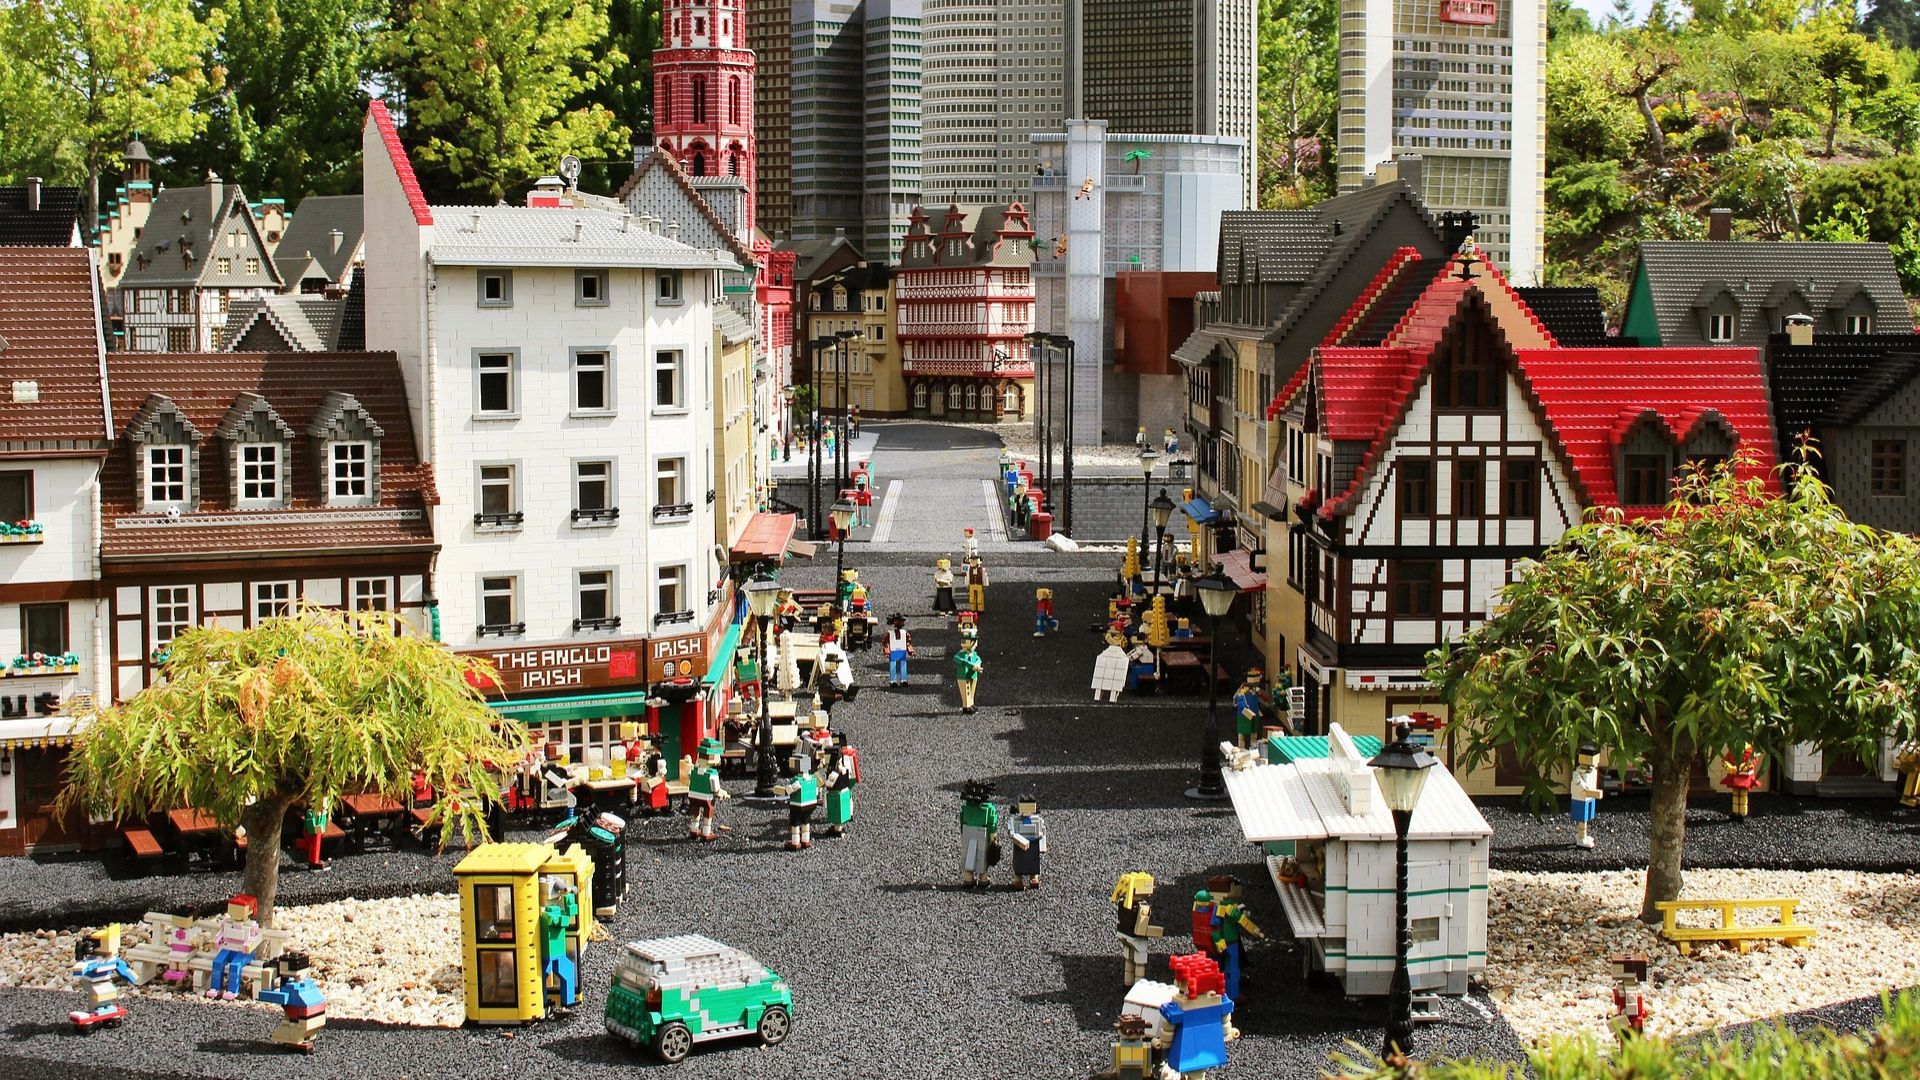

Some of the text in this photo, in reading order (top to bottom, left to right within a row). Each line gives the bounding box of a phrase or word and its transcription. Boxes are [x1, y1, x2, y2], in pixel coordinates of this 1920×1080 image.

[492, 646, 611, 669] THE ANGLO
[654, 638, 701, 658] IRISH
[523, 668, 581, 688] IRISH
